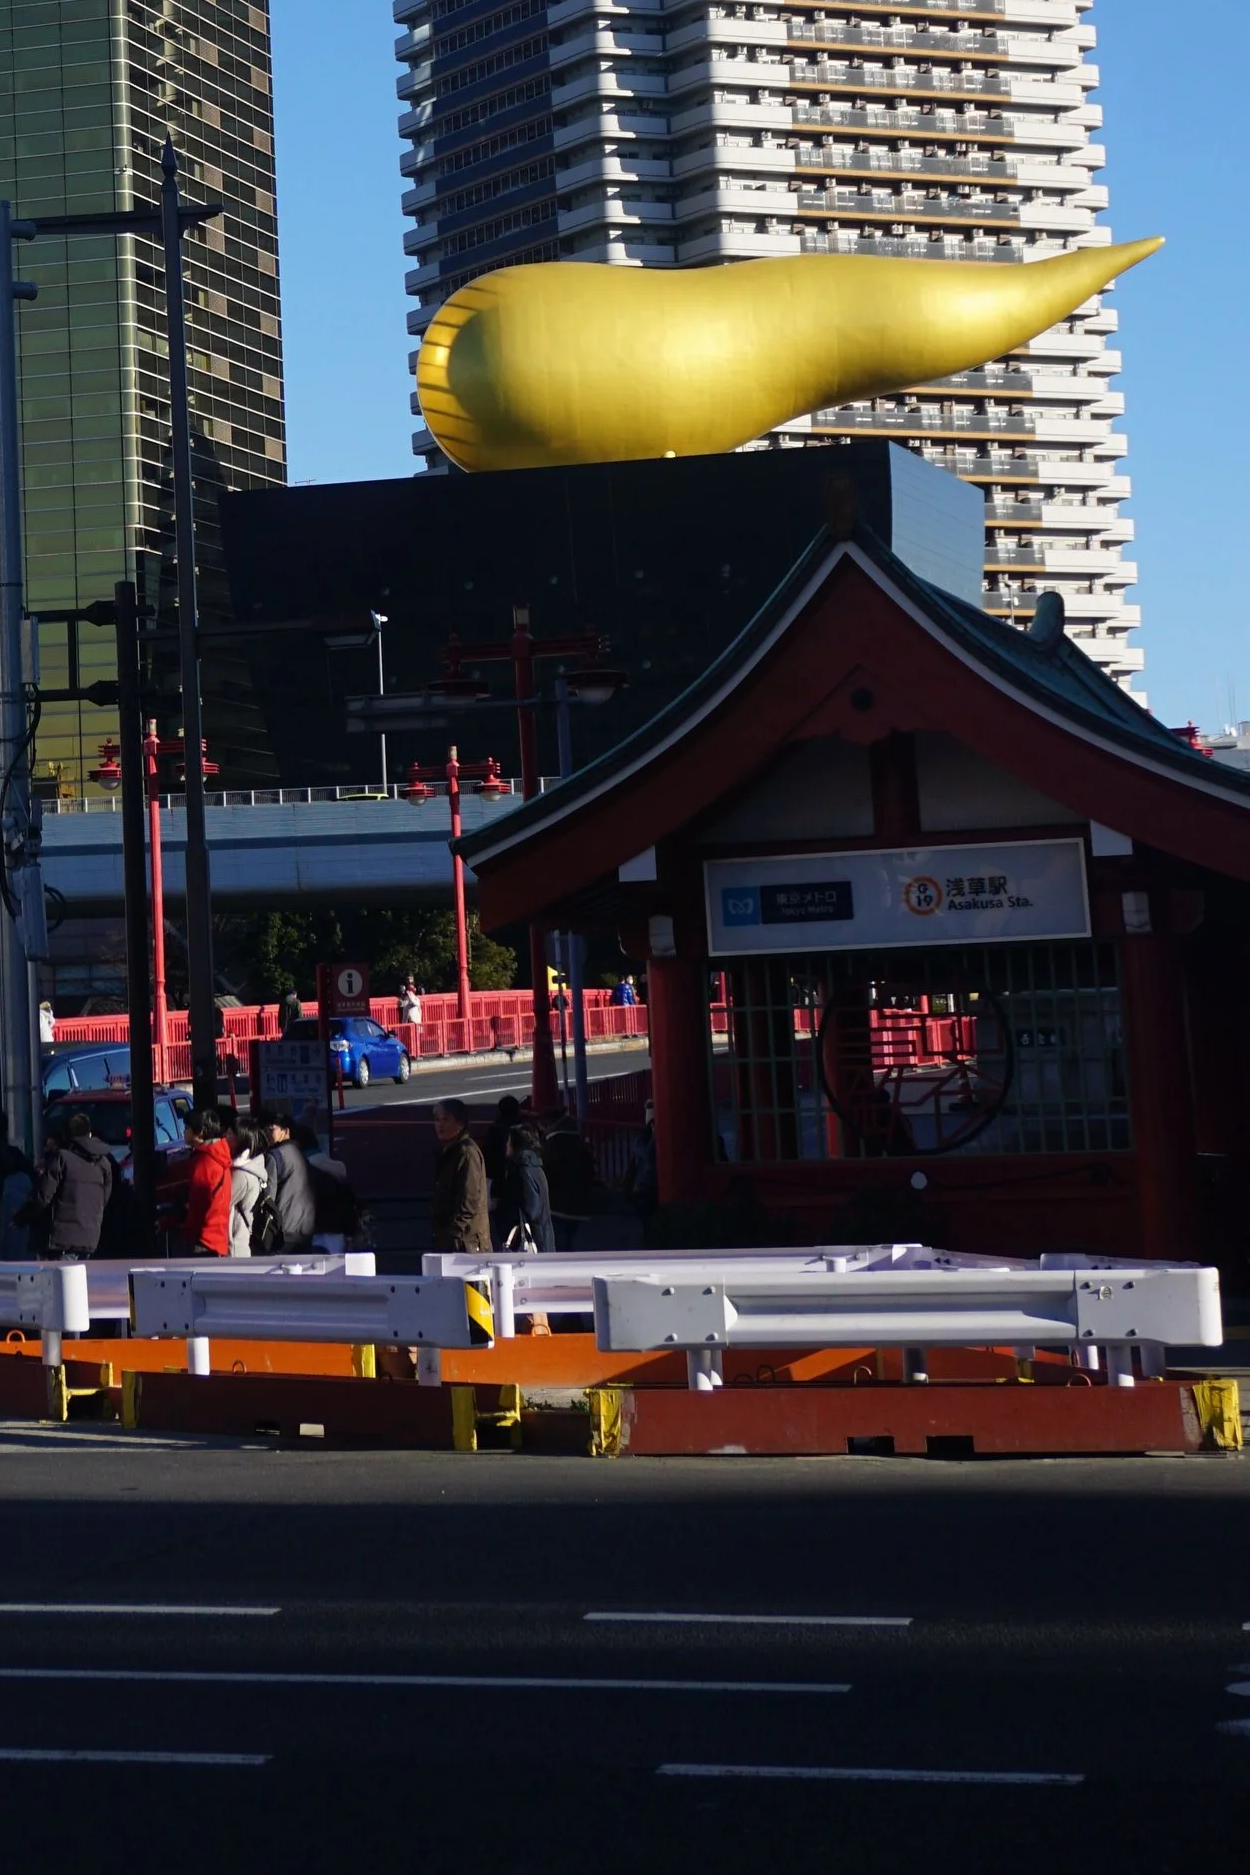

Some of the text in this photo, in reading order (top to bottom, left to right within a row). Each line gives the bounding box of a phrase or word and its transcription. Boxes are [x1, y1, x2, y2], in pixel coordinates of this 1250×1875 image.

[917, 883, 928, 894] G
[946, 876, 1008, 897] 浅草駅
[775, 890, 836, 905] 東京メトロ
[916, 895, 933, 907] 19
[948, 896, 1034, 910] Asakusa Sta.
[780, 904, 835, 917] Tokyo Metro
